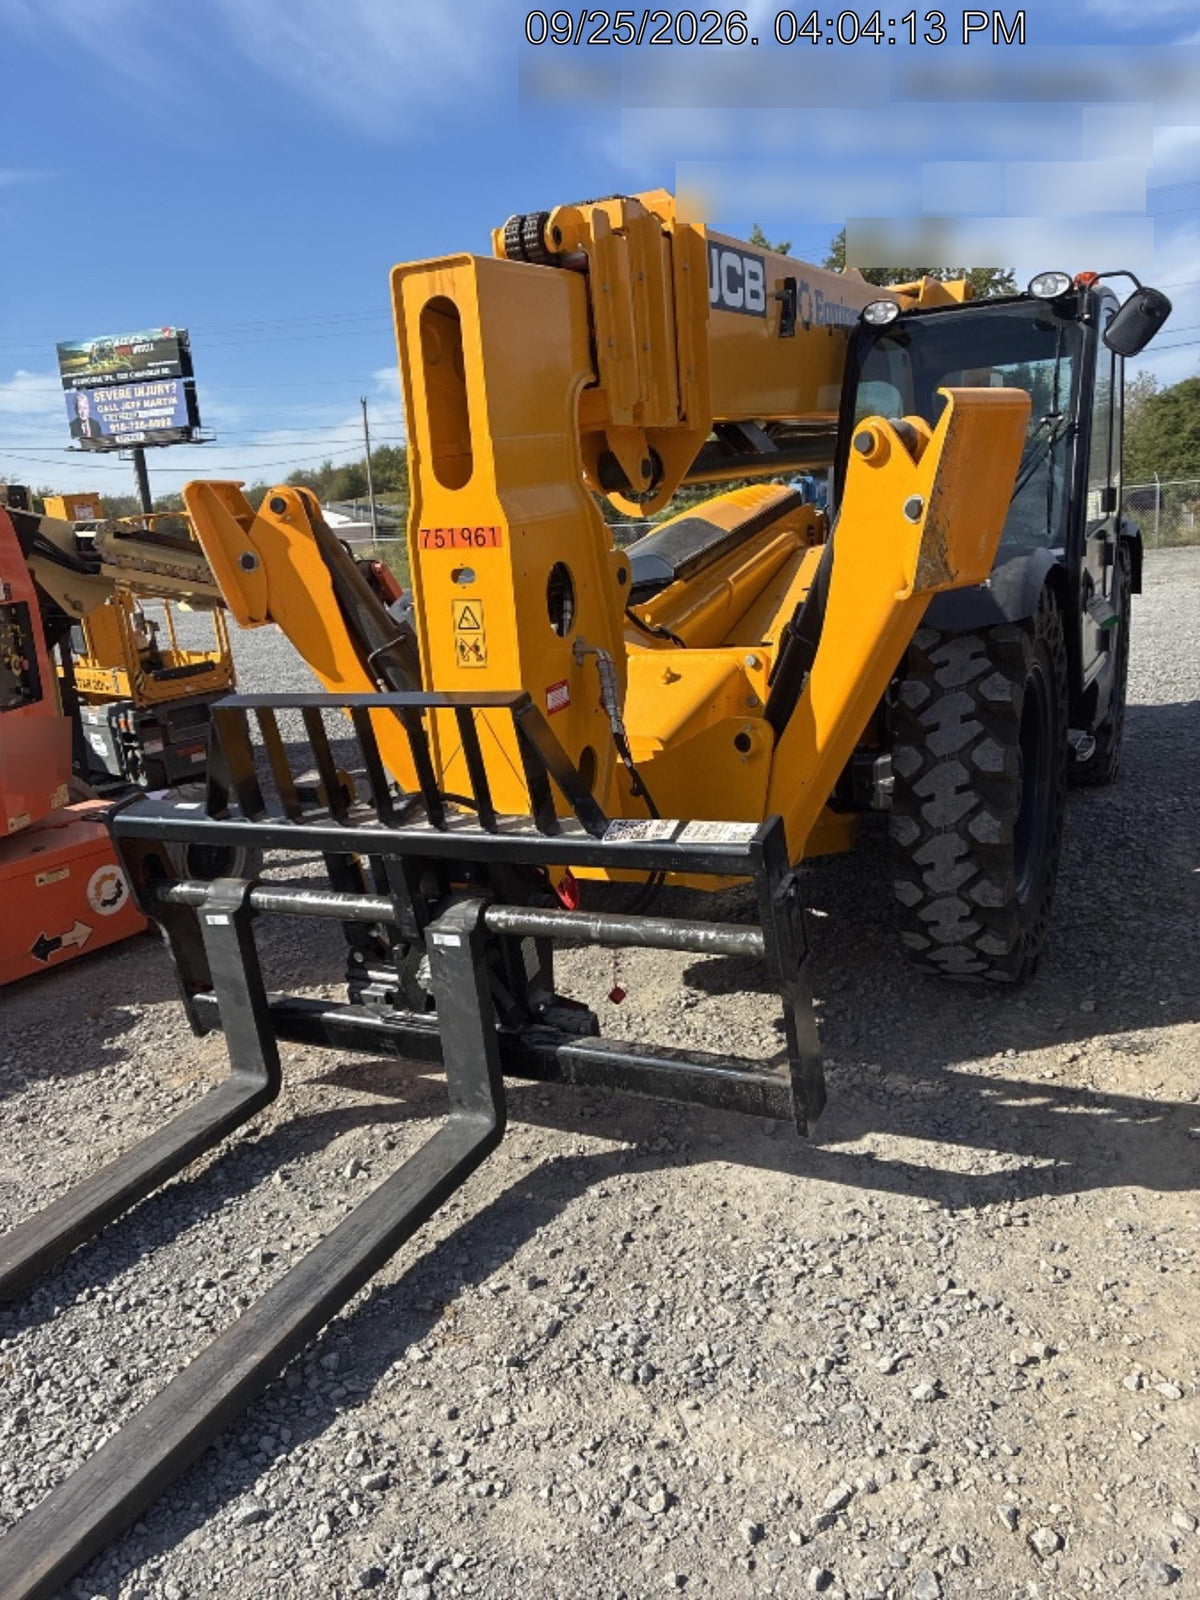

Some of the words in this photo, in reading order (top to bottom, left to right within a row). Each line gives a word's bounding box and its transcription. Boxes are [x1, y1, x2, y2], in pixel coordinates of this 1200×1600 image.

[709, 248, 765, 312] JCB
[93, 387, 132, 402] SEVERE
[134, 382, 177, 397] INJURY?
[97, 403, 119, 413] CALL
[121, 399, 140, 411] JEFF
[143, 397, 178, 408] MARTIN
[420, 526, 498, 549] 751961
